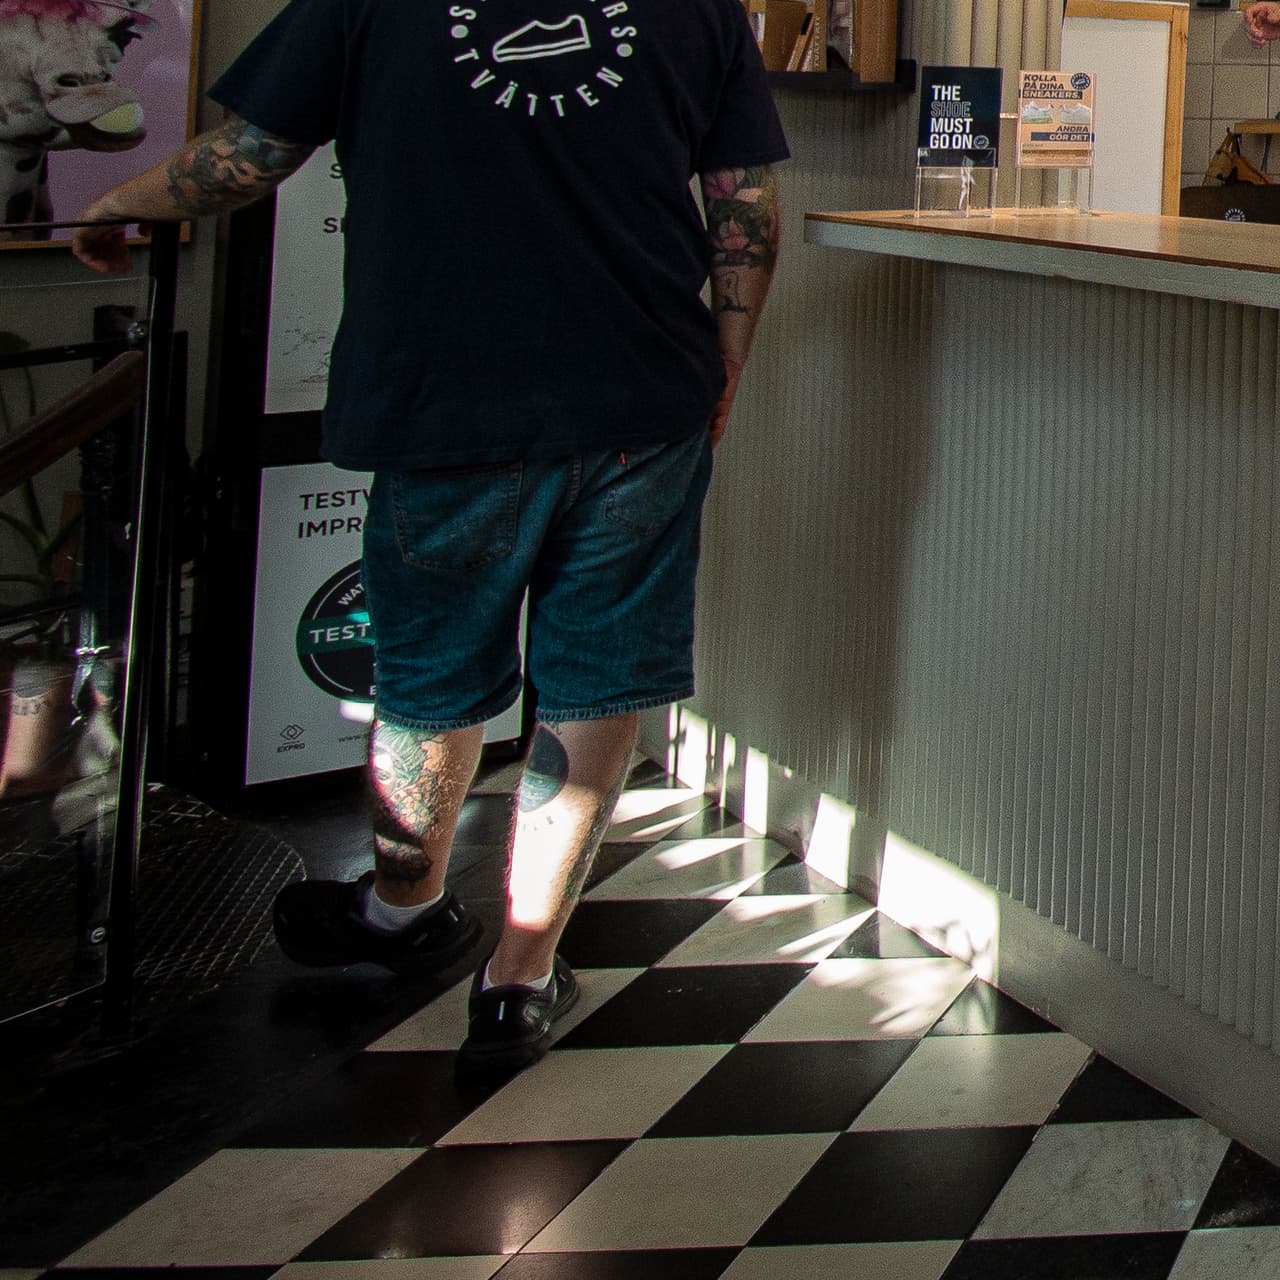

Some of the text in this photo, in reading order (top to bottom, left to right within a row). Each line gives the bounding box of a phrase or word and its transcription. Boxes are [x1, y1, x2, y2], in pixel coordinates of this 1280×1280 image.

[454, 48, 623, 117] TVÄTTEN
[1024, 81, 1037, 90] PÅ
[931, 85, 961, 101] THE
[930, 101, 971, 117] SHOE
[930, 117, 973, 133] MUST
[929, 133, 973, 149] GO ON
